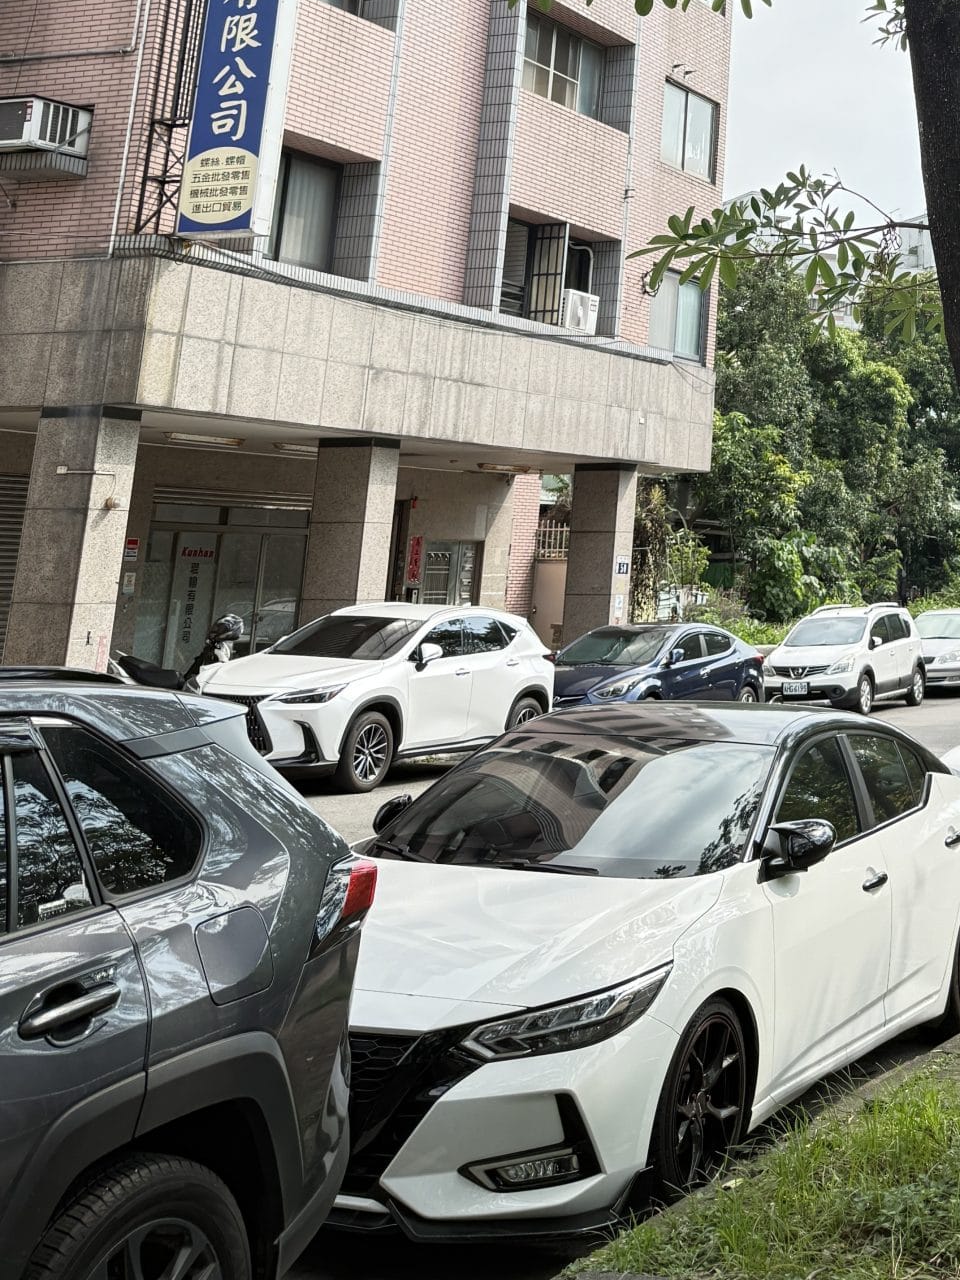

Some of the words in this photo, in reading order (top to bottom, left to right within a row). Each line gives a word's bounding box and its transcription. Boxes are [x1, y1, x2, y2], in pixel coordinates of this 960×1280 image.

[190, 170, 250, 183] 五金批發零售
[191, 201, 242, 213] 進出口貿易
